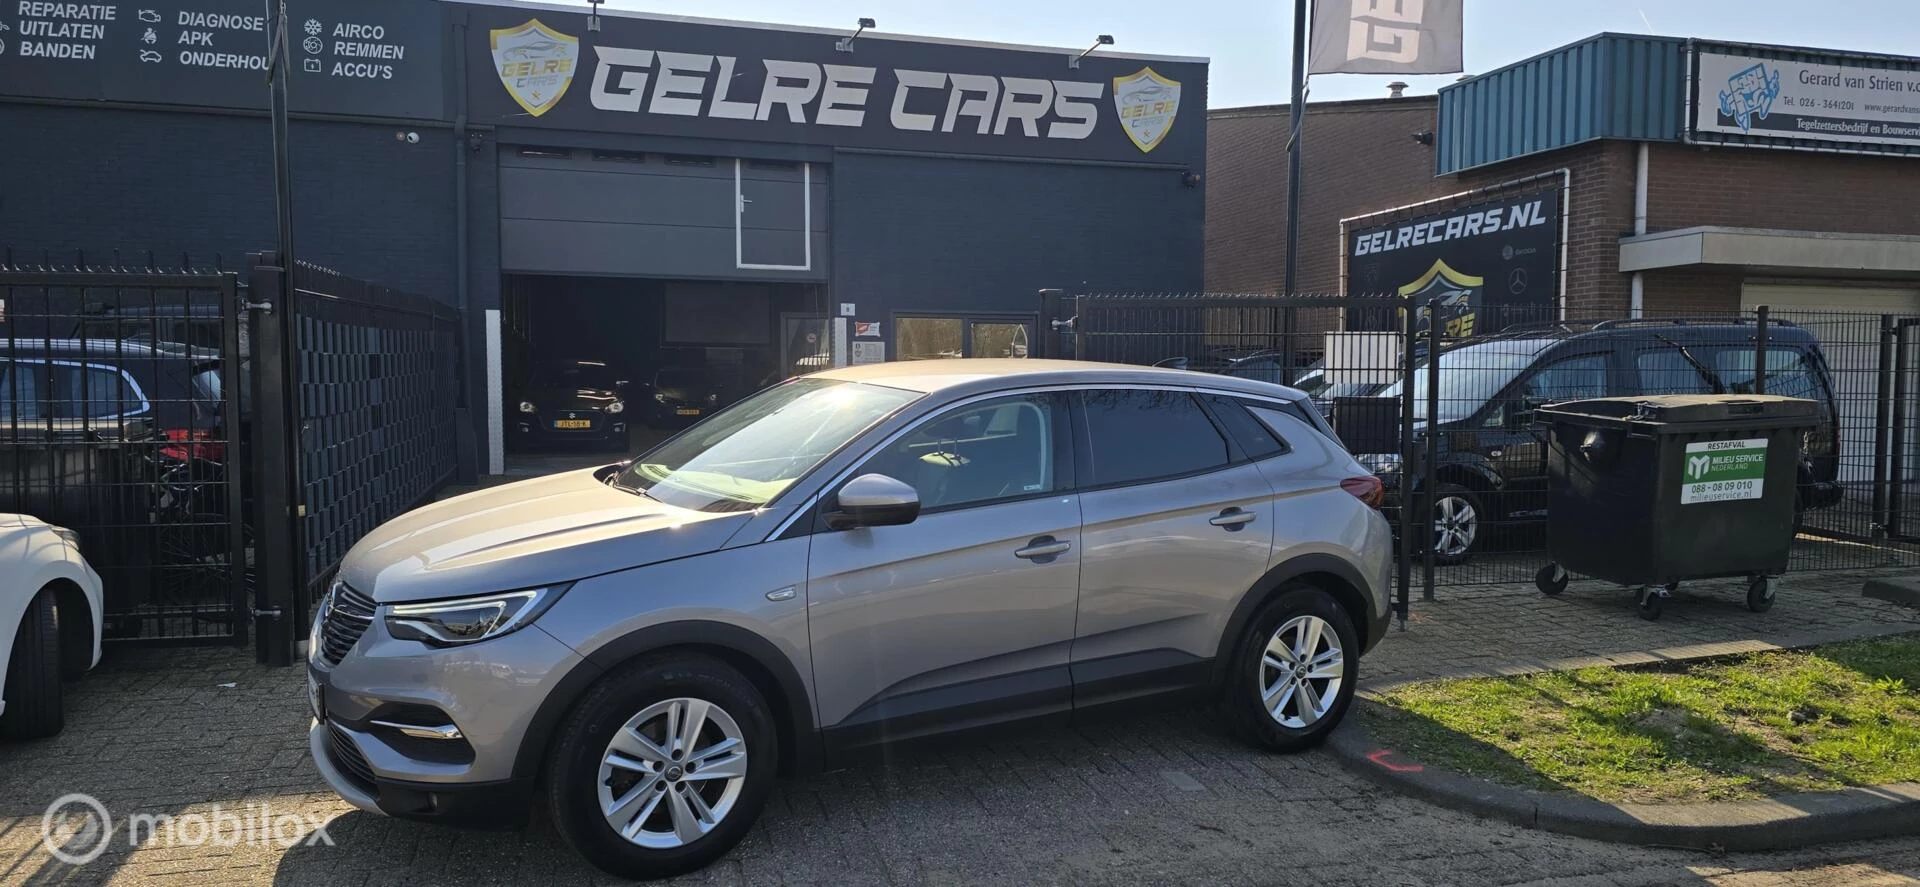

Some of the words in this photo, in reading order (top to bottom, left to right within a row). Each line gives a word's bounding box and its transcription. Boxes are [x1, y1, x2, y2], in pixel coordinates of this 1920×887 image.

[18, 0, 117, 20] REPARATIE
[20, 20, 105, 40] UITLATEN
[178, 11, 265, 31] DIAGNOSE
[178, 30, 215, 47] APK
[332, 22, 385, 40] AIRCO
[20, 41, 96, 60] BANDEN
[334, 41, 405, 60] REMMEN
[179, 50, 270, 71] ONDERHOU
[501, 59, 572, 78] GELRE
[331, 61, 394, 80] ACCU'S
[1799, 69, 1841, 87] Gerard
[1844, 77, 1865, 89] van
[1868, 75, 1903, 92] Strien
[590, 46, 877, 127] GELRE
[890, 69, 1105, 140] CARS
[1799, 97, 1816, 107] 026
[1121, 101, 1177, 119] GELRE
[1796, 118, 1869, 135] Tegelzettersbedrijf
[1870, 125, 1881, 134] en
[1355, 200, 1546, 256] GELRECARS.NL
[1707, 441, 1745, 450] RESTAFVAL
[1711, 463, 1749, 472] NEDERLAND
[1712, 455, 1735, 464] MILIEU
[1735, 454, 1764, 463] SERVICE
[1691, 483, 1706, 494] 088
[1713, 482, 1722, 491] 08
[1724, 482, 1735, 490] 09
[1737, 481, 1752, 490] 010
[1691, 490, 1752, 502] milieuservice.nl
